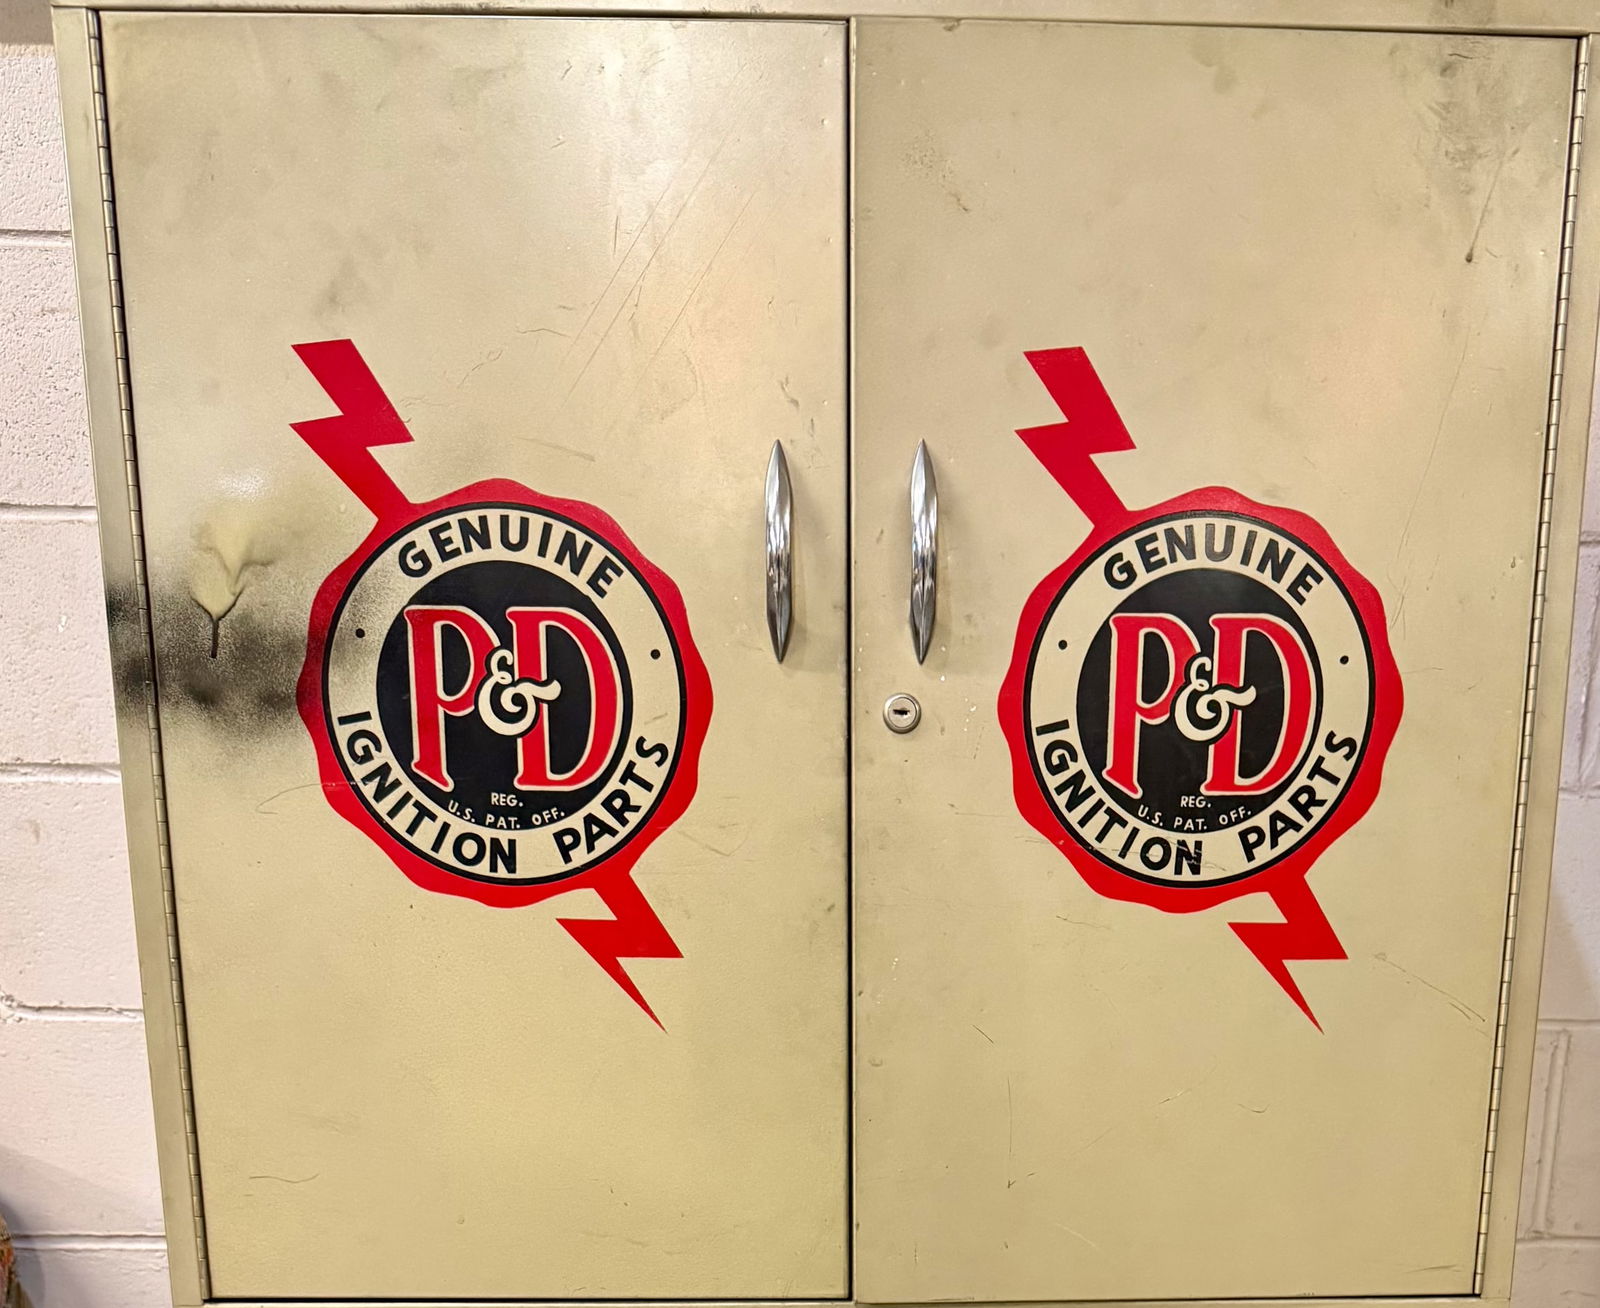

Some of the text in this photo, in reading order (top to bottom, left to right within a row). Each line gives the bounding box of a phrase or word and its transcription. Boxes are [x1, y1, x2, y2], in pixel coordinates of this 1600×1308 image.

[399, 514, 624, 599] GENUINE
[1103, 523, 1324, 606] GENUINE
[403, 605, 624, 792] P&D
[1103, 613, 1317, 799] P&D
[337, 710, 669, 874] IGNITION PARTS
[448, 799, 565, 829] U.S. PAT. OFF.
[491, 792, 523, 807] REG.
[1035, 719, 1358, 876] IGNITION PARTS
[1137, 805, 1252, 831] U.S. PAT. OFF.
[1180, 795, 1212, 808] REG.
